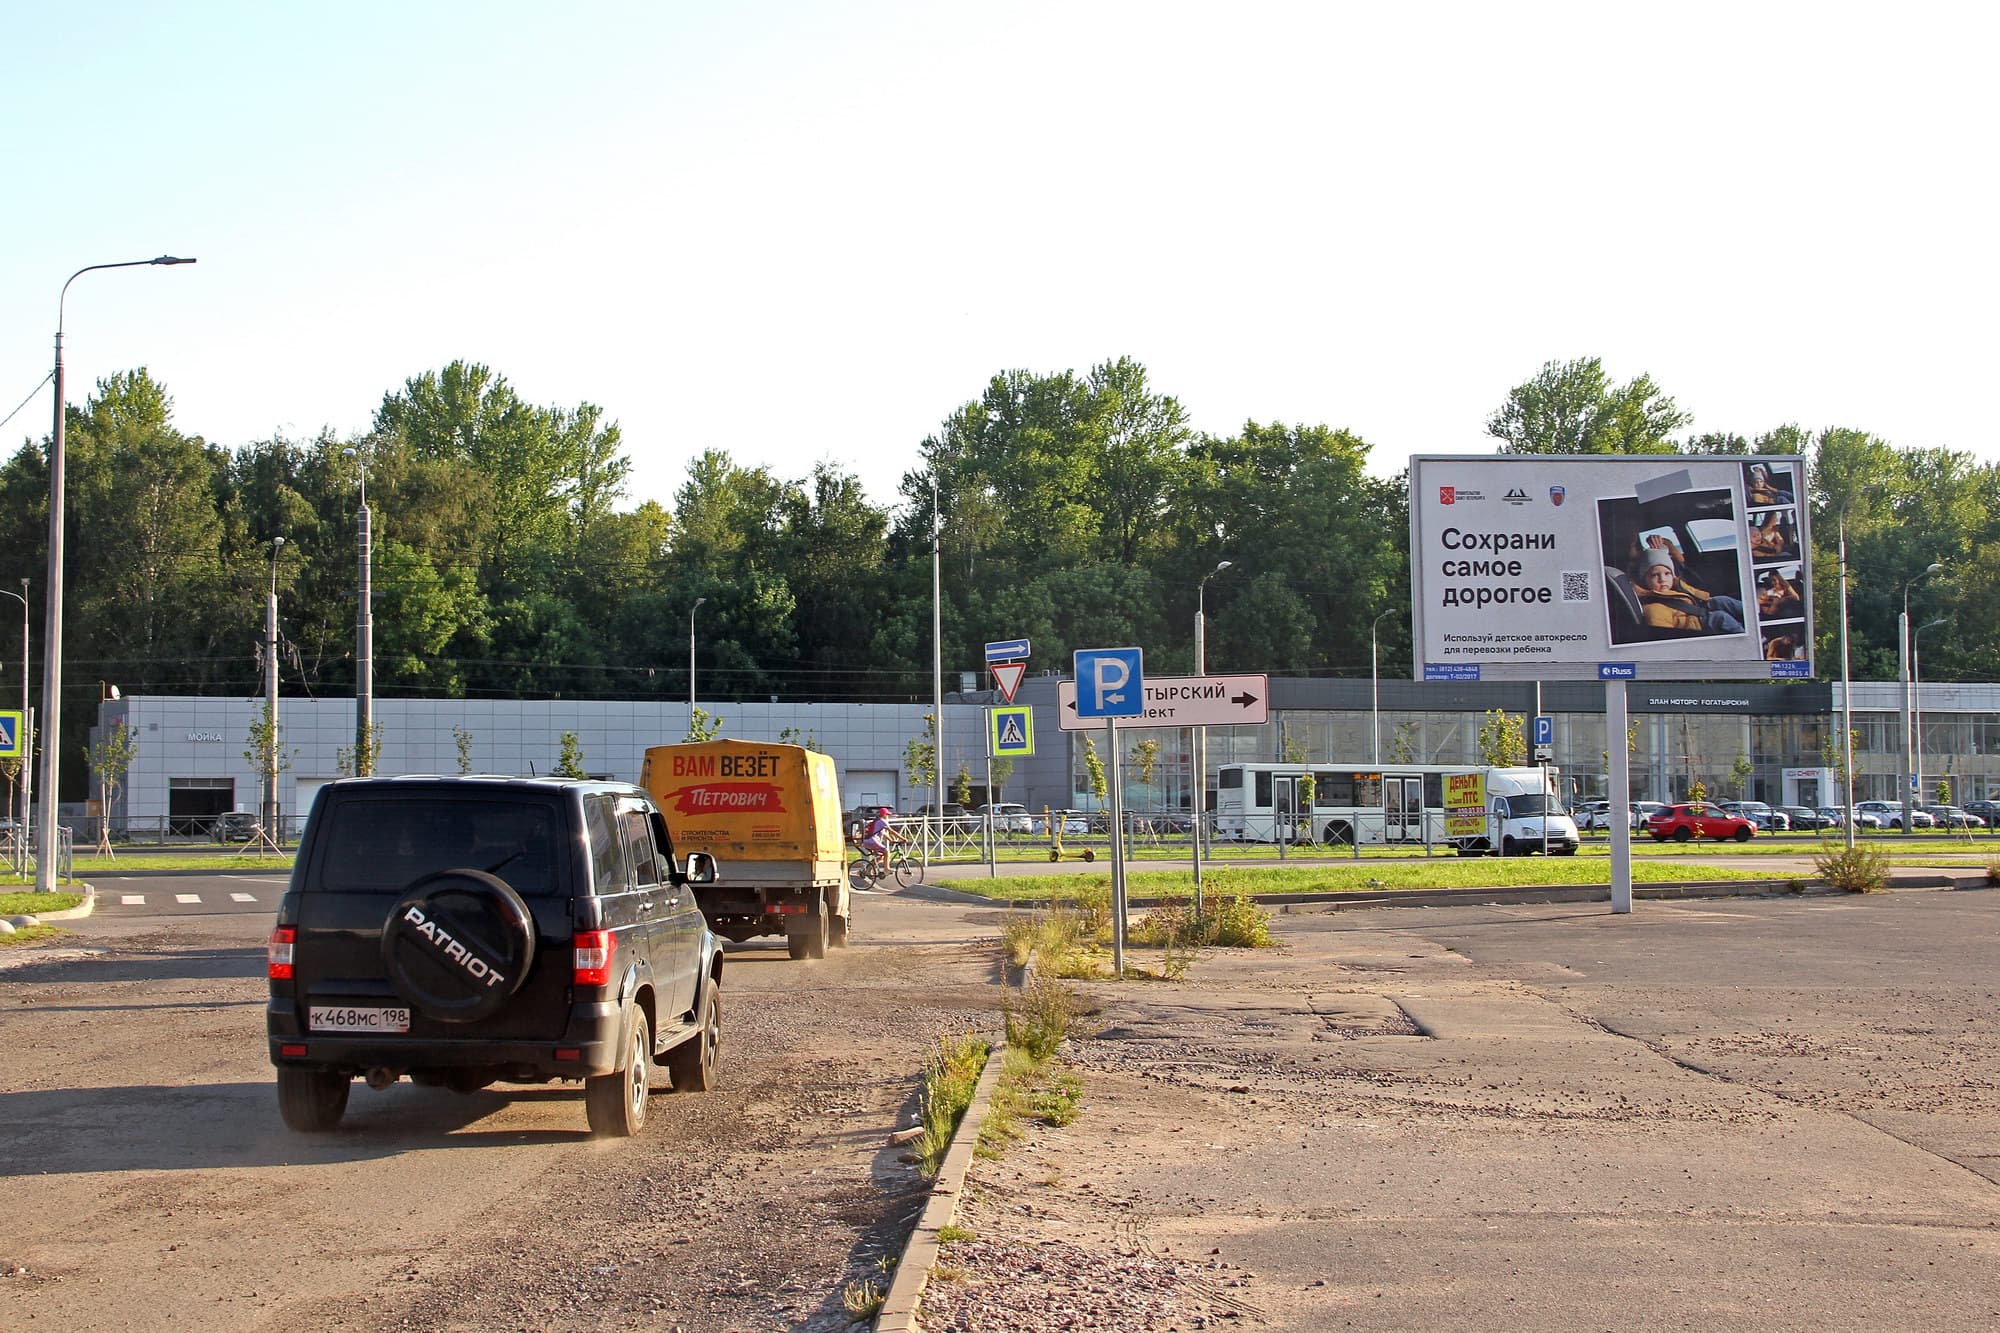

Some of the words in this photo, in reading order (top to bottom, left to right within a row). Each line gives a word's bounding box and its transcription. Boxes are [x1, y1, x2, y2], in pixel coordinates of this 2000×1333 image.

[1441, 527, 1555, 555] Сохрани
[1442, 560, 1522, 577] самое
[1442, 587, 1552, 609] дорогое
[1443, 633, 1492, 644] Используй
[1494, 634, 1532, 642] детское
[1534, 634, 1587, 643] автокресло
[1462, 646, 1510, 656] перевозки
[1513, 645, 1552, 655] ребенка
[1611, 667, 1632, 675] Russ
[1144, 681, 1226, 701] ТЫРСКИЙ
[187, 731, 222, 741] МОЙКА
[673, 755, 715, 777] ВАМ
[720, 751, 781, 777] ВЕЗЁТ
[1449, 773, 1478, 792] ДЕНЬГИ
[1462, 791, 1478, 804] ПТС
[403, 906, 505, 987] PATRIOT
[382, 1009, 406, 1022] 198
